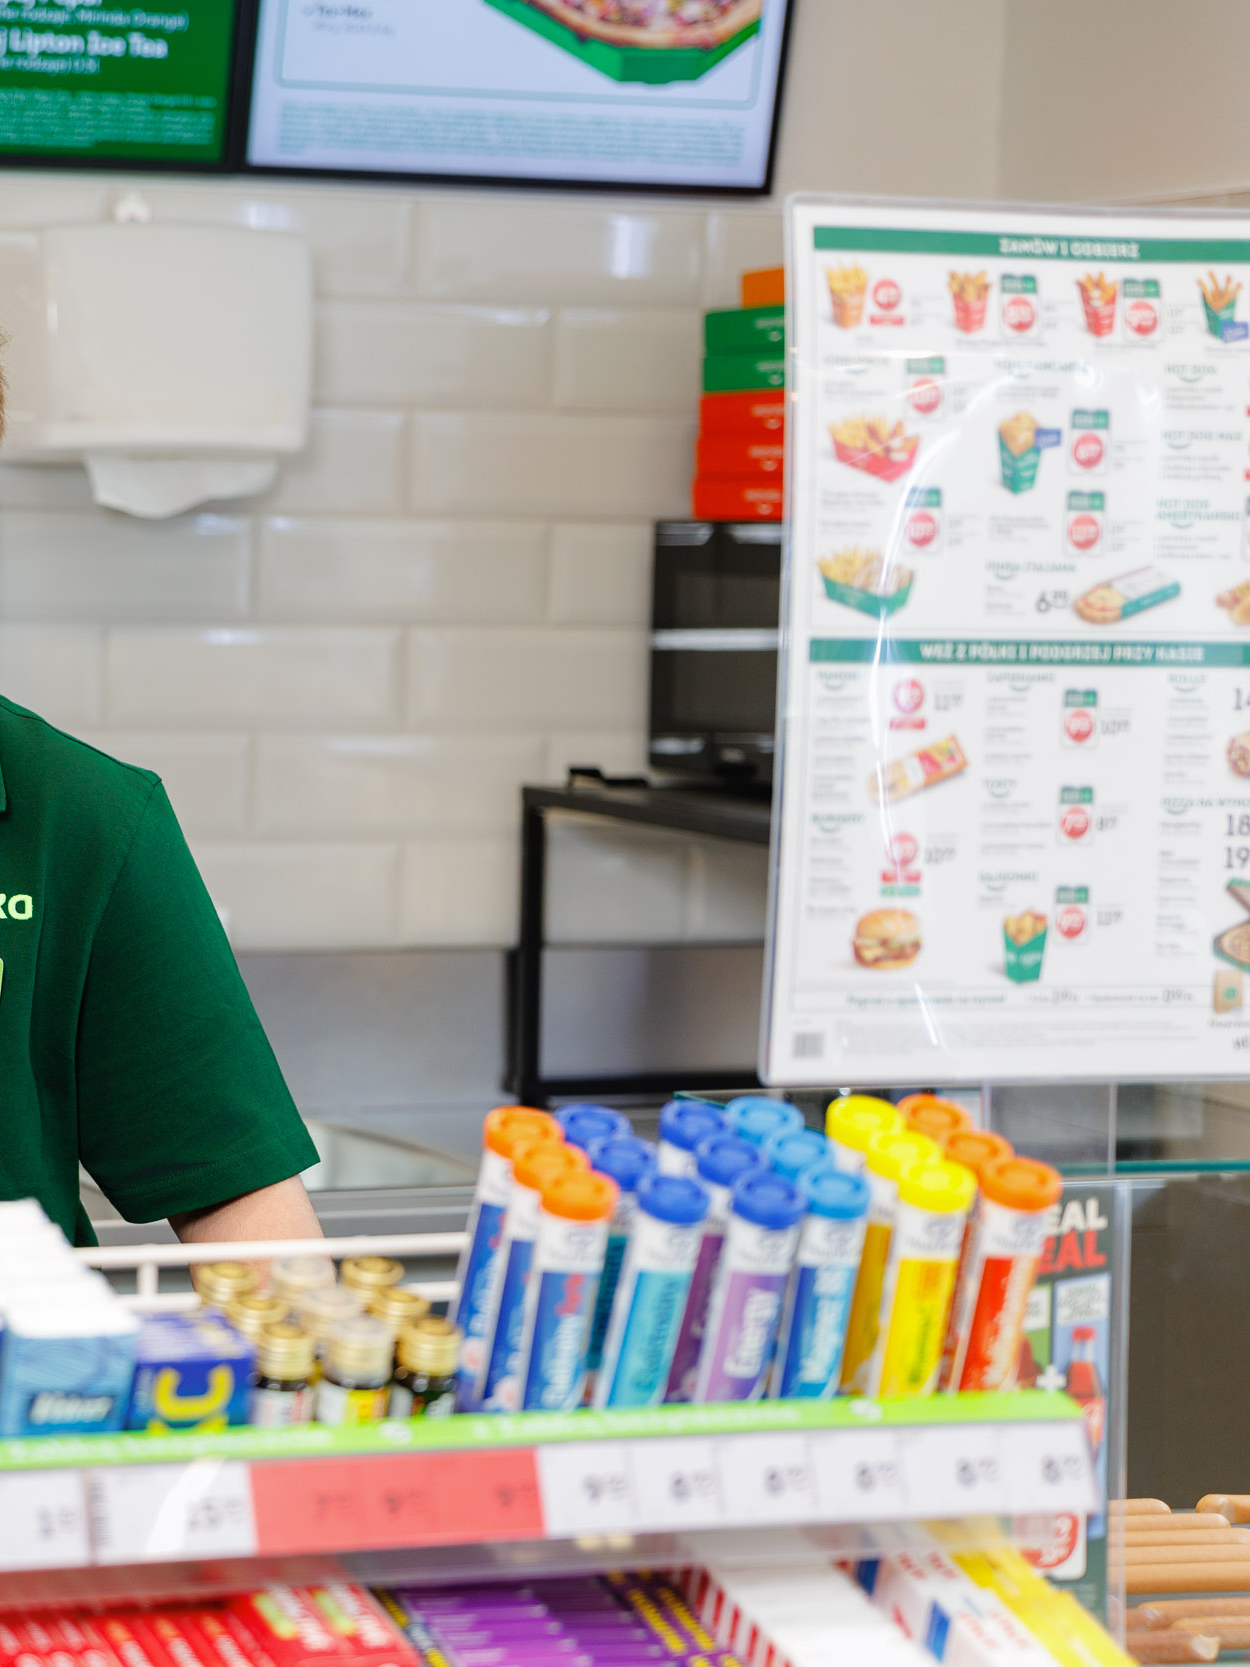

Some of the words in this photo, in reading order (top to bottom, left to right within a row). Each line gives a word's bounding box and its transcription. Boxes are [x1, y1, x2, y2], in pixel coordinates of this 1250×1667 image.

[9, 26, 85, 56] Lipton
[86, 30, 127, 57] Ice
[127, 31, 169, 58] Tea
[1070, 241, 1140, 259] ODBIERZ
[1041, 1196, 1110, 1237] EAL
[1036, 1229, 1109, 1275] EAL
